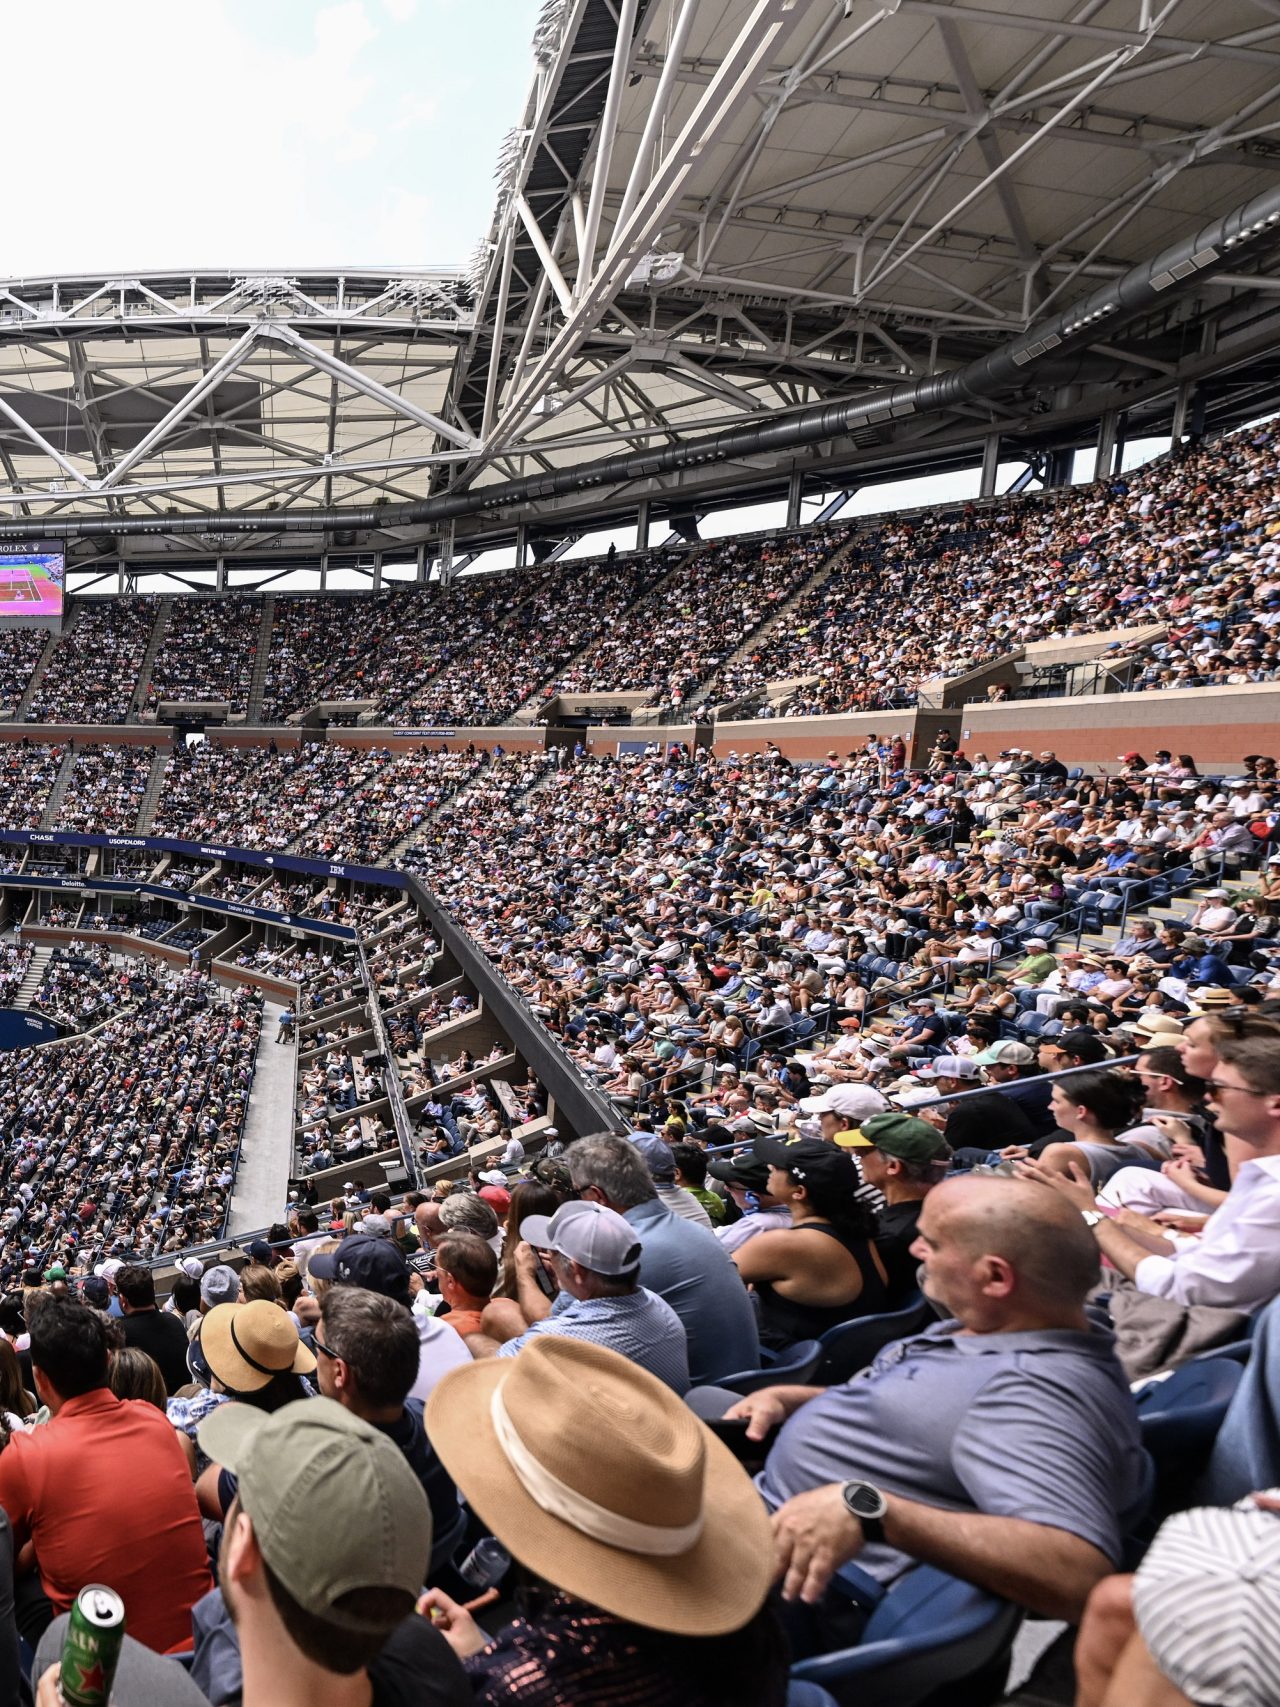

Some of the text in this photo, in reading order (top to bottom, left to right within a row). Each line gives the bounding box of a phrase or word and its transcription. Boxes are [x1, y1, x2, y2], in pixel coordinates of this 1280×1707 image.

[330, 865, 344, 875] IBM
[24, 1017, 43, 1026] AMERICAN
[26, 1022, 43, 1030] EXPRESS
